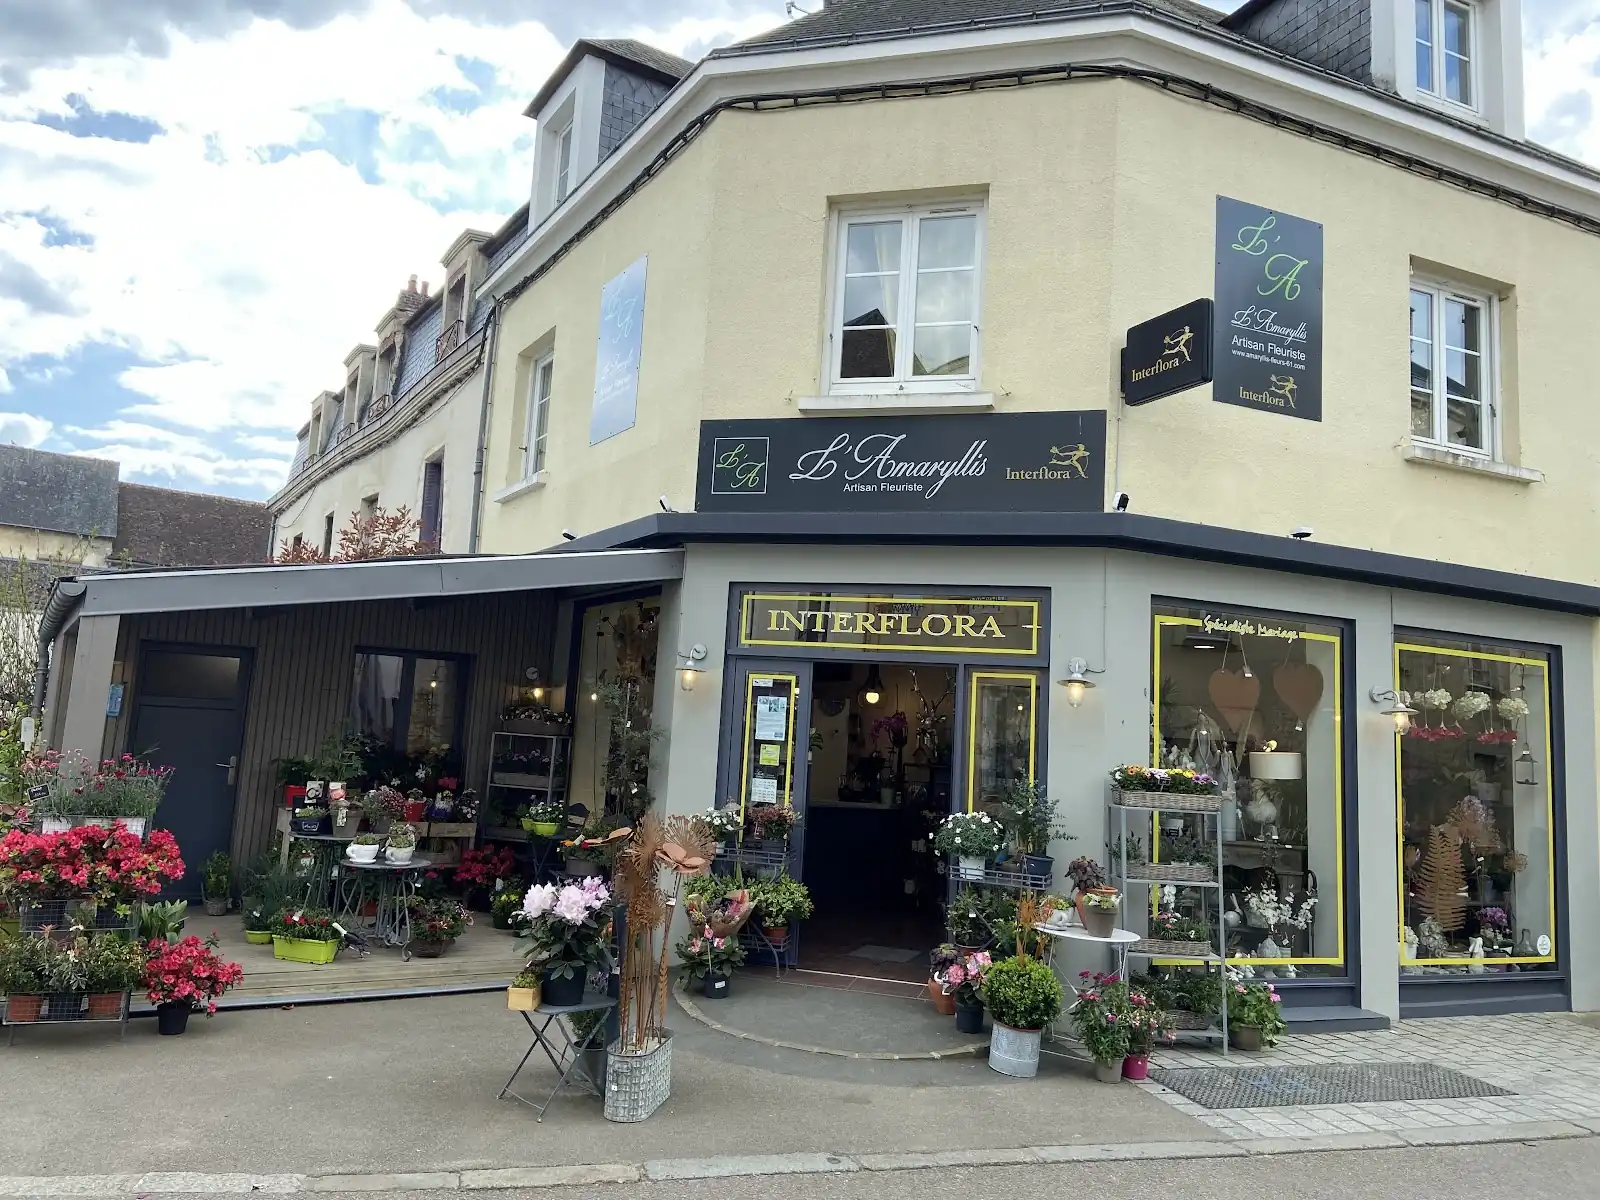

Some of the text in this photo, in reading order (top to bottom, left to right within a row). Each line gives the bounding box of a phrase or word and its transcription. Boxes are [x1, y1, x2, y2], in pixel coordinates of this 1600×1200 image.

[1231, 305, 1307, 346] L'Amaryllis
[1231, 349, 1306, 371] www.amaryllis-fleurs-61.com
[1232, 335, 1306, 361] Artisan Fleuriste
[1132, 357, 1180, 383] Interflora
[1239, 386, 1285, 407] Interflora
[788, 432, 988, 499] L'Amaryllis
[1005, 466, 1071, 480] Interflora
[843, 482, 923, 492] Artisan Fleuriste
[767, 609, 1007, 638] INTERFLORA
